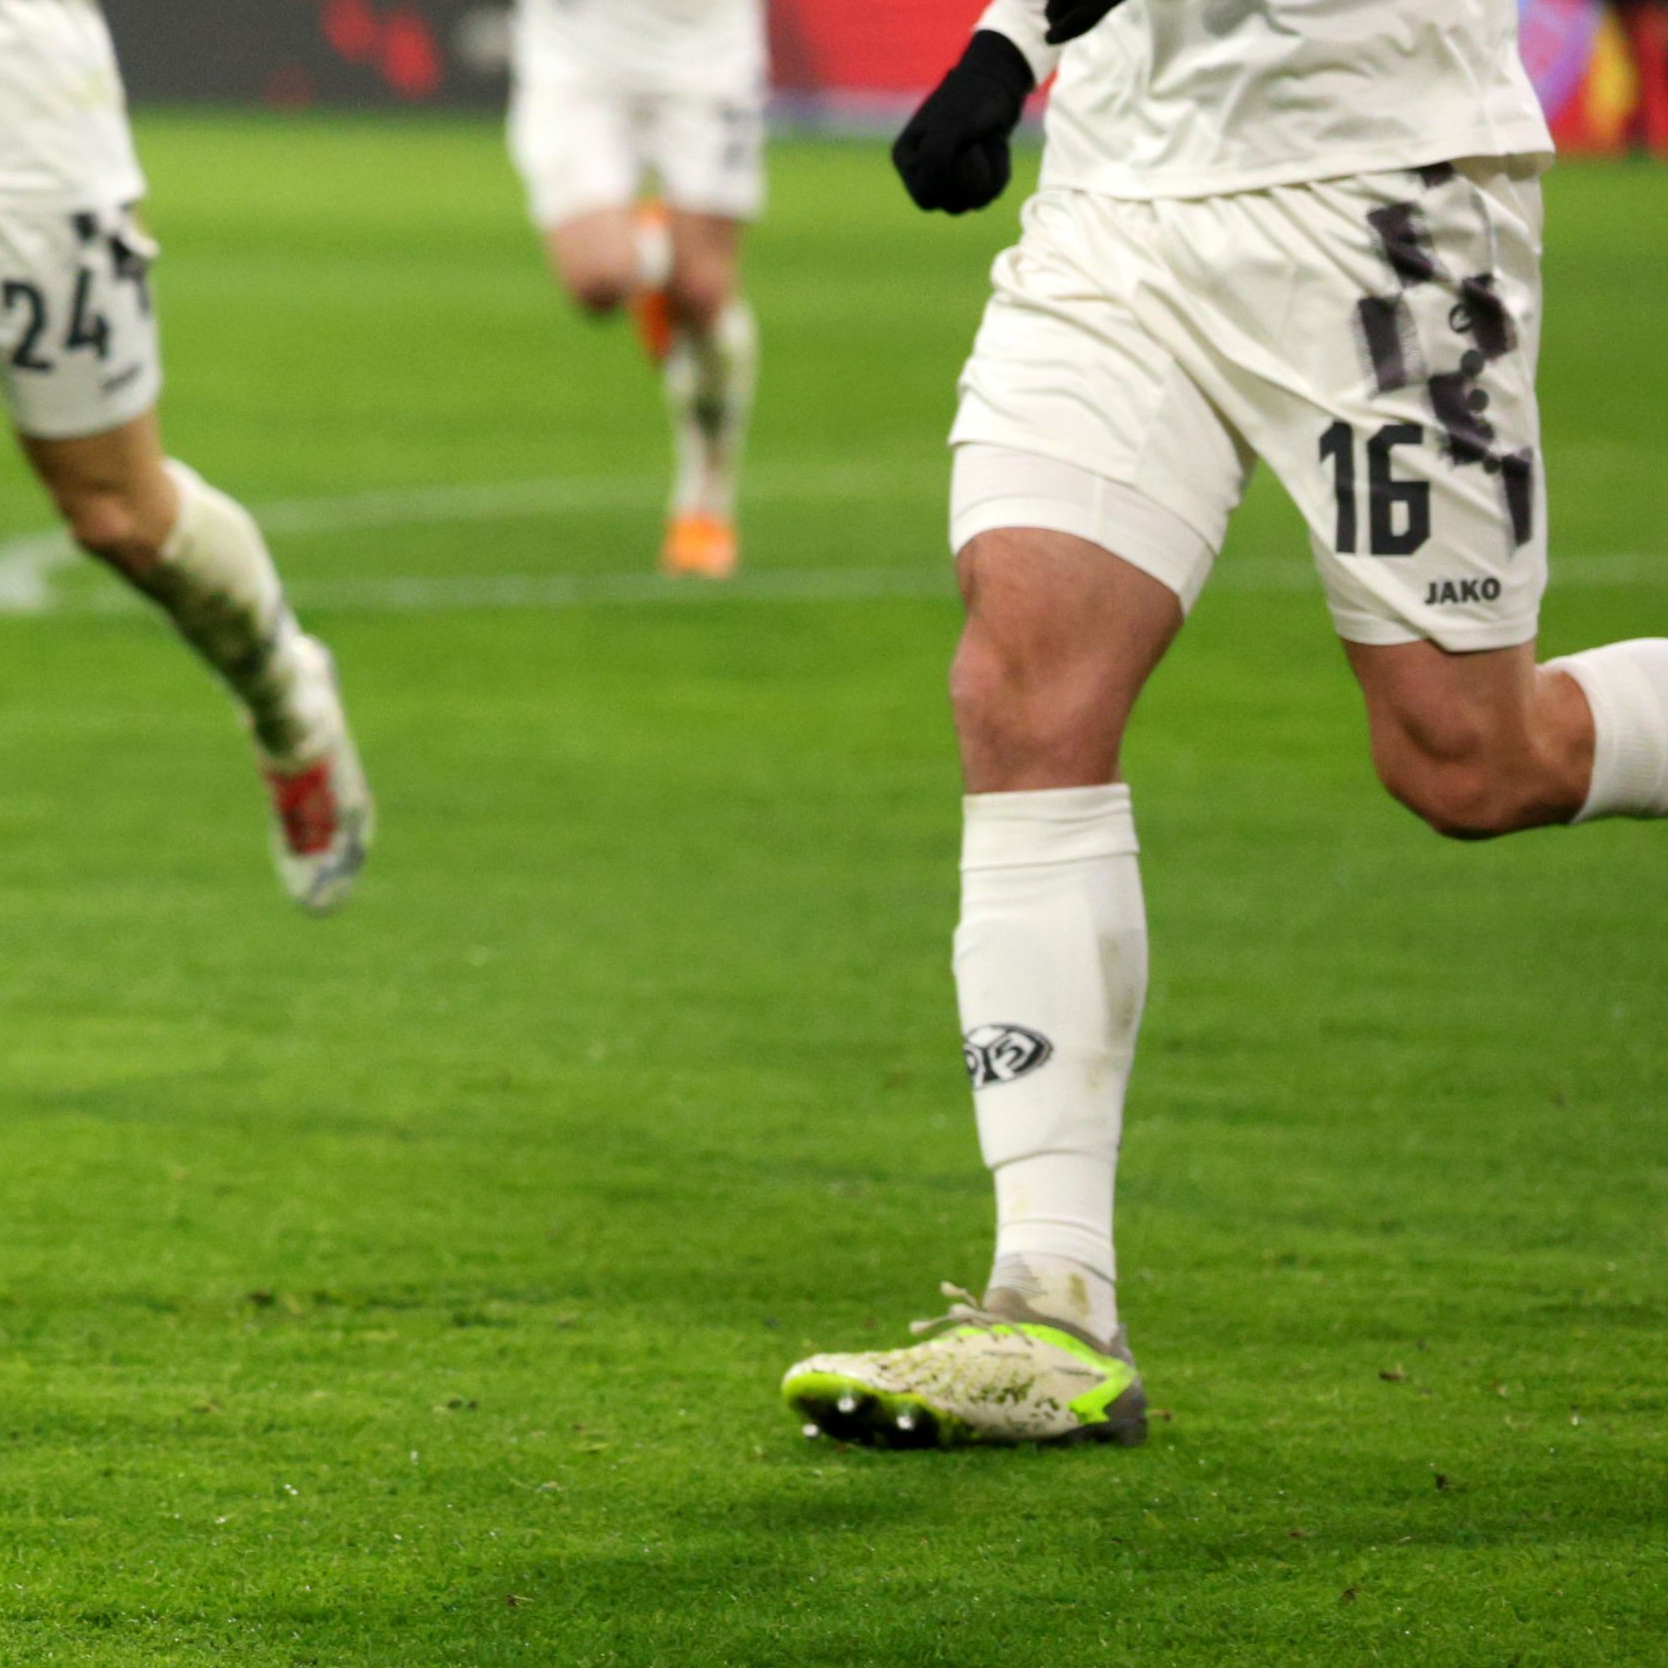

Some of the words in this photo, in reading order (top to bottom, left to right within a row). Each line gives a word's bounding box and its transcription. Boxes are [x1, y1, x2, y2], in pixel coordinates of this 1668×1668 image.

[1, 266, 111, 373] 24
[1318, 420, 1431, 557] 16
[1424, 576, 1503, 606] JAKO
